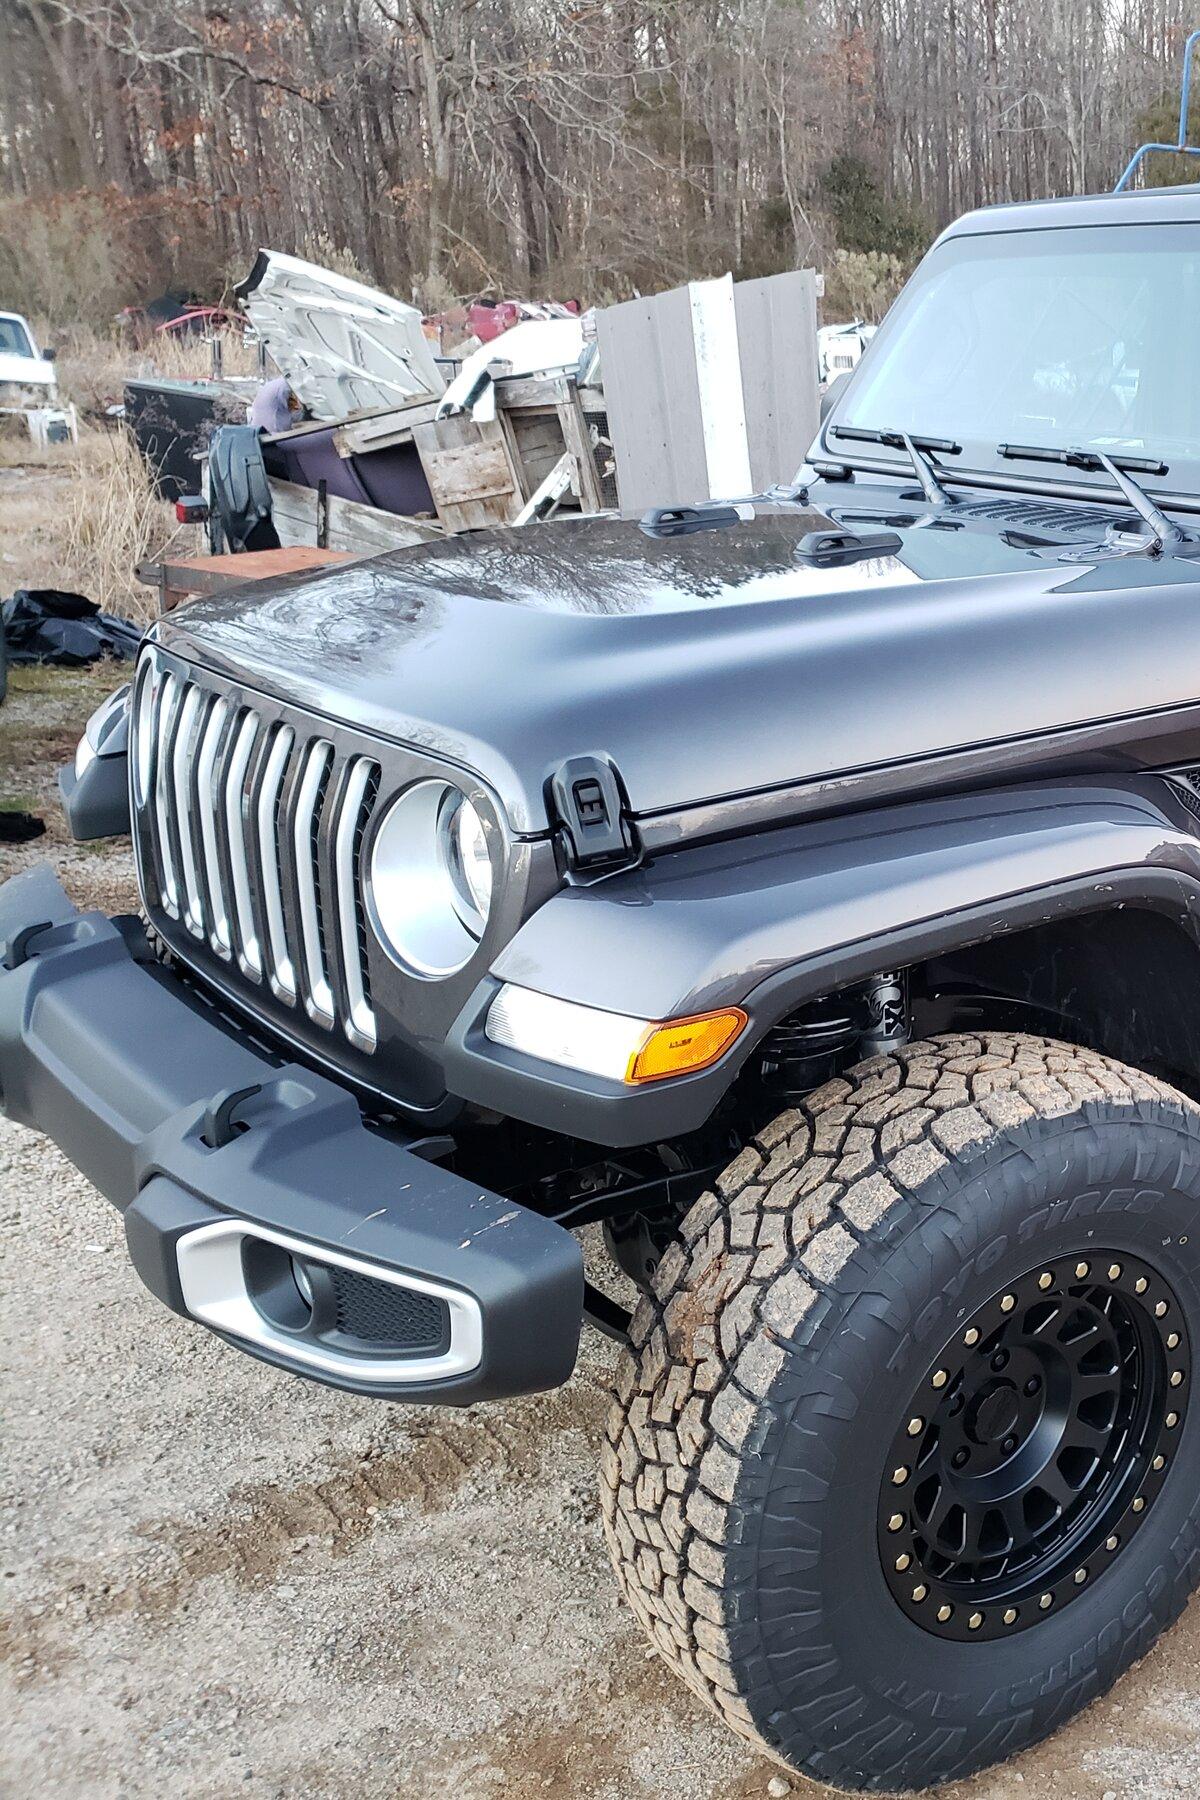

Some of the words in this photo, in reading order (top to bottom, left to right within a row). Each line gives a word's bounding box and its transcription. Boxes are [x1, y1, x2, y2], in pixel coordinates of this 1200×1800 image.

[886, 1234, 1009, 1372] TOYO
[1016, 1187, 1166, 1244] TIRES
[976, 1564, 1169, 1717] COUNTRY
